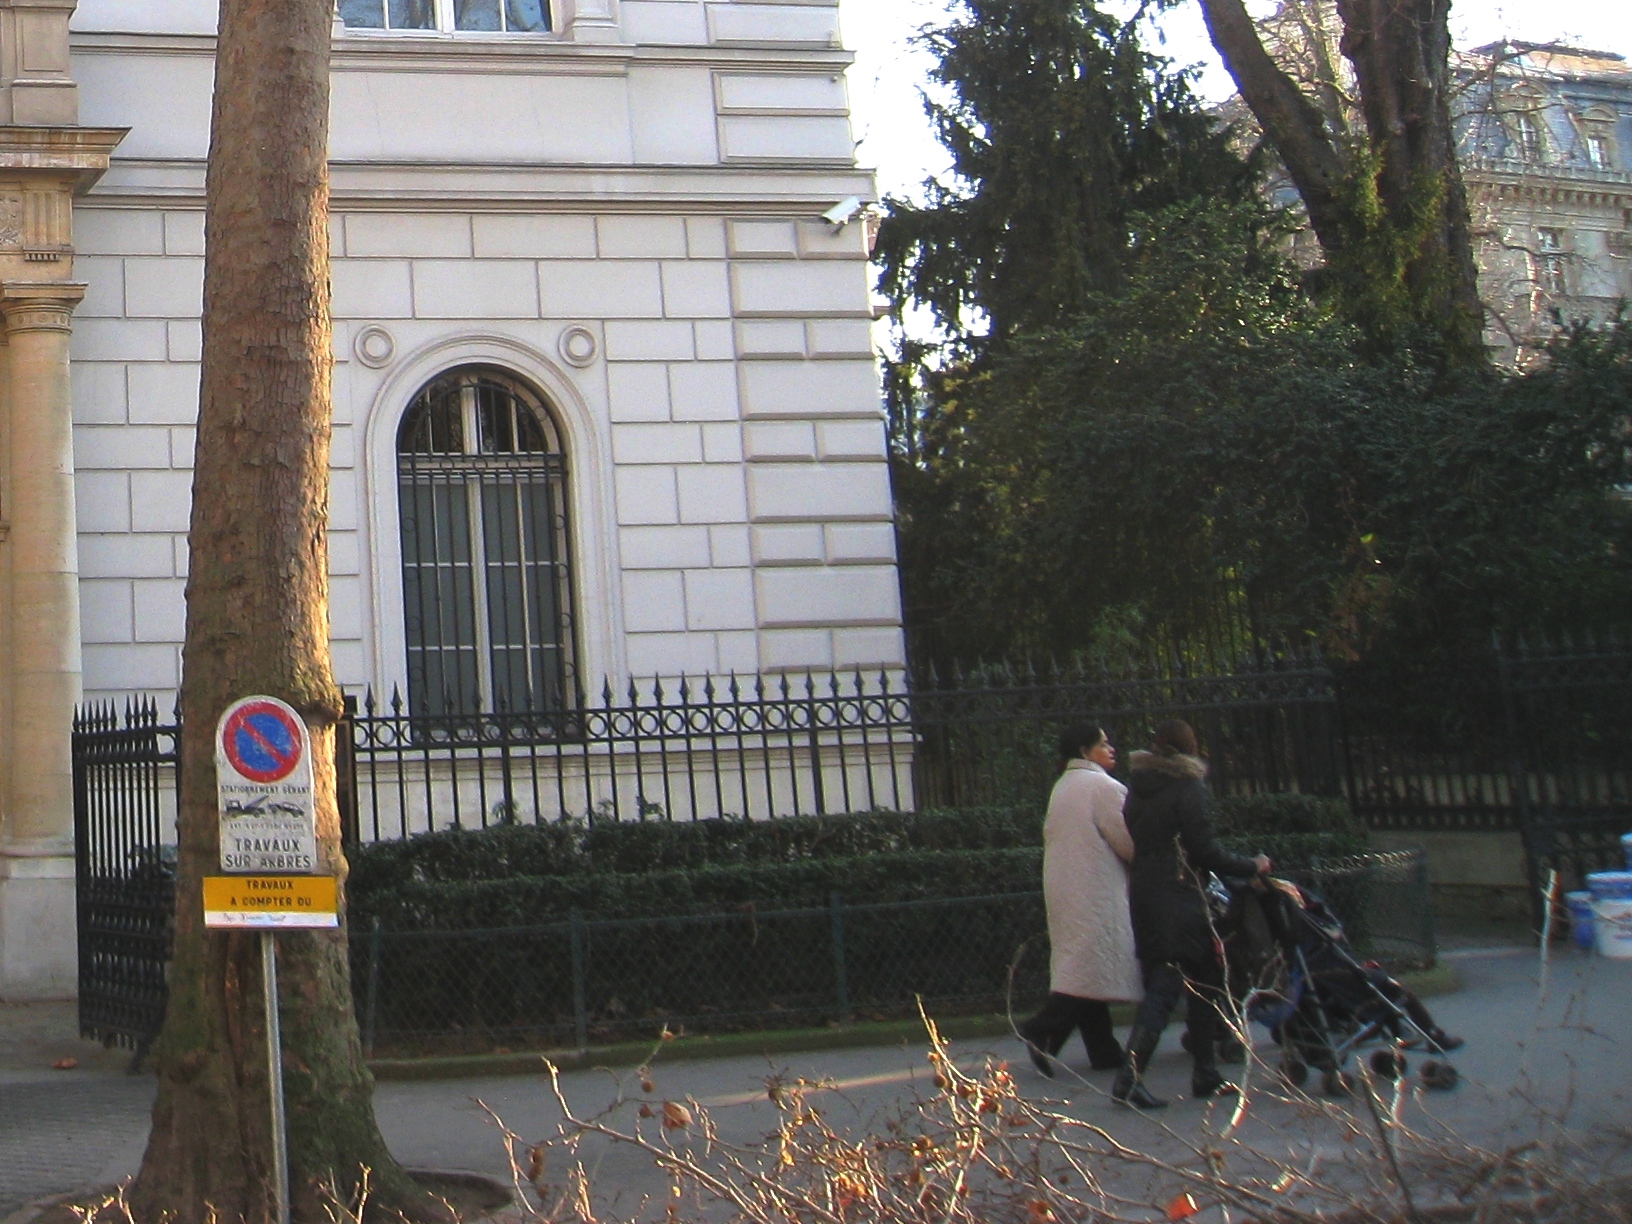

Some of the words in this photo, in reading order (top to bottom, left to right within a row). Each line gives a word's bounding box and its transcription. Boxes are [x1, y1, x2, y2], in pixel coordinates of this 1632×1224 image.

[235, 838, 301, 853] TRAVAUX
[225, 854, 252, 868] SUR
[246, 880, 294, 890] TRAVAUX
[242, 897, 293, 907] COMPTER
[297, 897, 312, 907] DU
